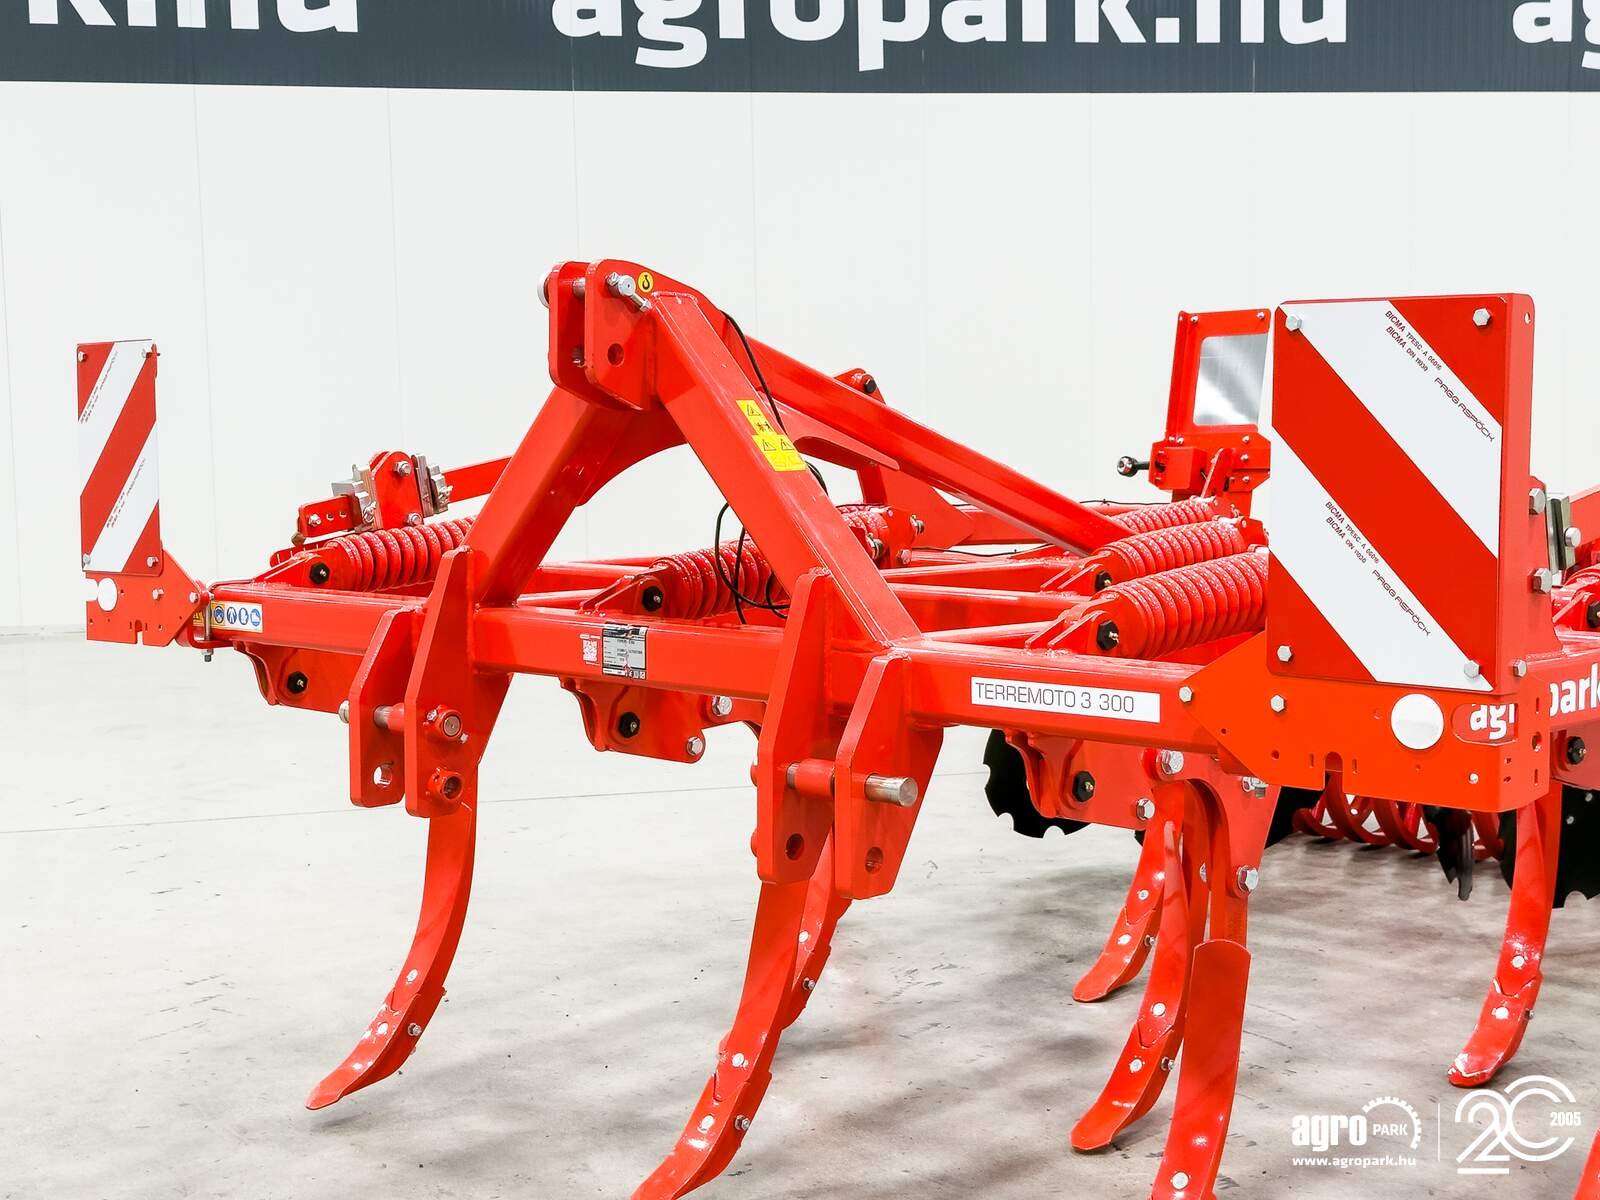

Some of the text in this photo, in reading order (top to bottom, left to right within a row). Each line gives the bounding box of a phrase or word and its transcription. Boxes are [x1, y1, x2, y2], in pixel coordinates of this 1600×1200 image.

[1385, 310, 1406, 333] BICMA
[1386, 326, 1406, 349] BICMA
[1325, 501, 1344, 524] BICMA
[1326, 516, 1345, 539] BICMA
[975, 682, 1135, 713] TERREMOTO 3 300
